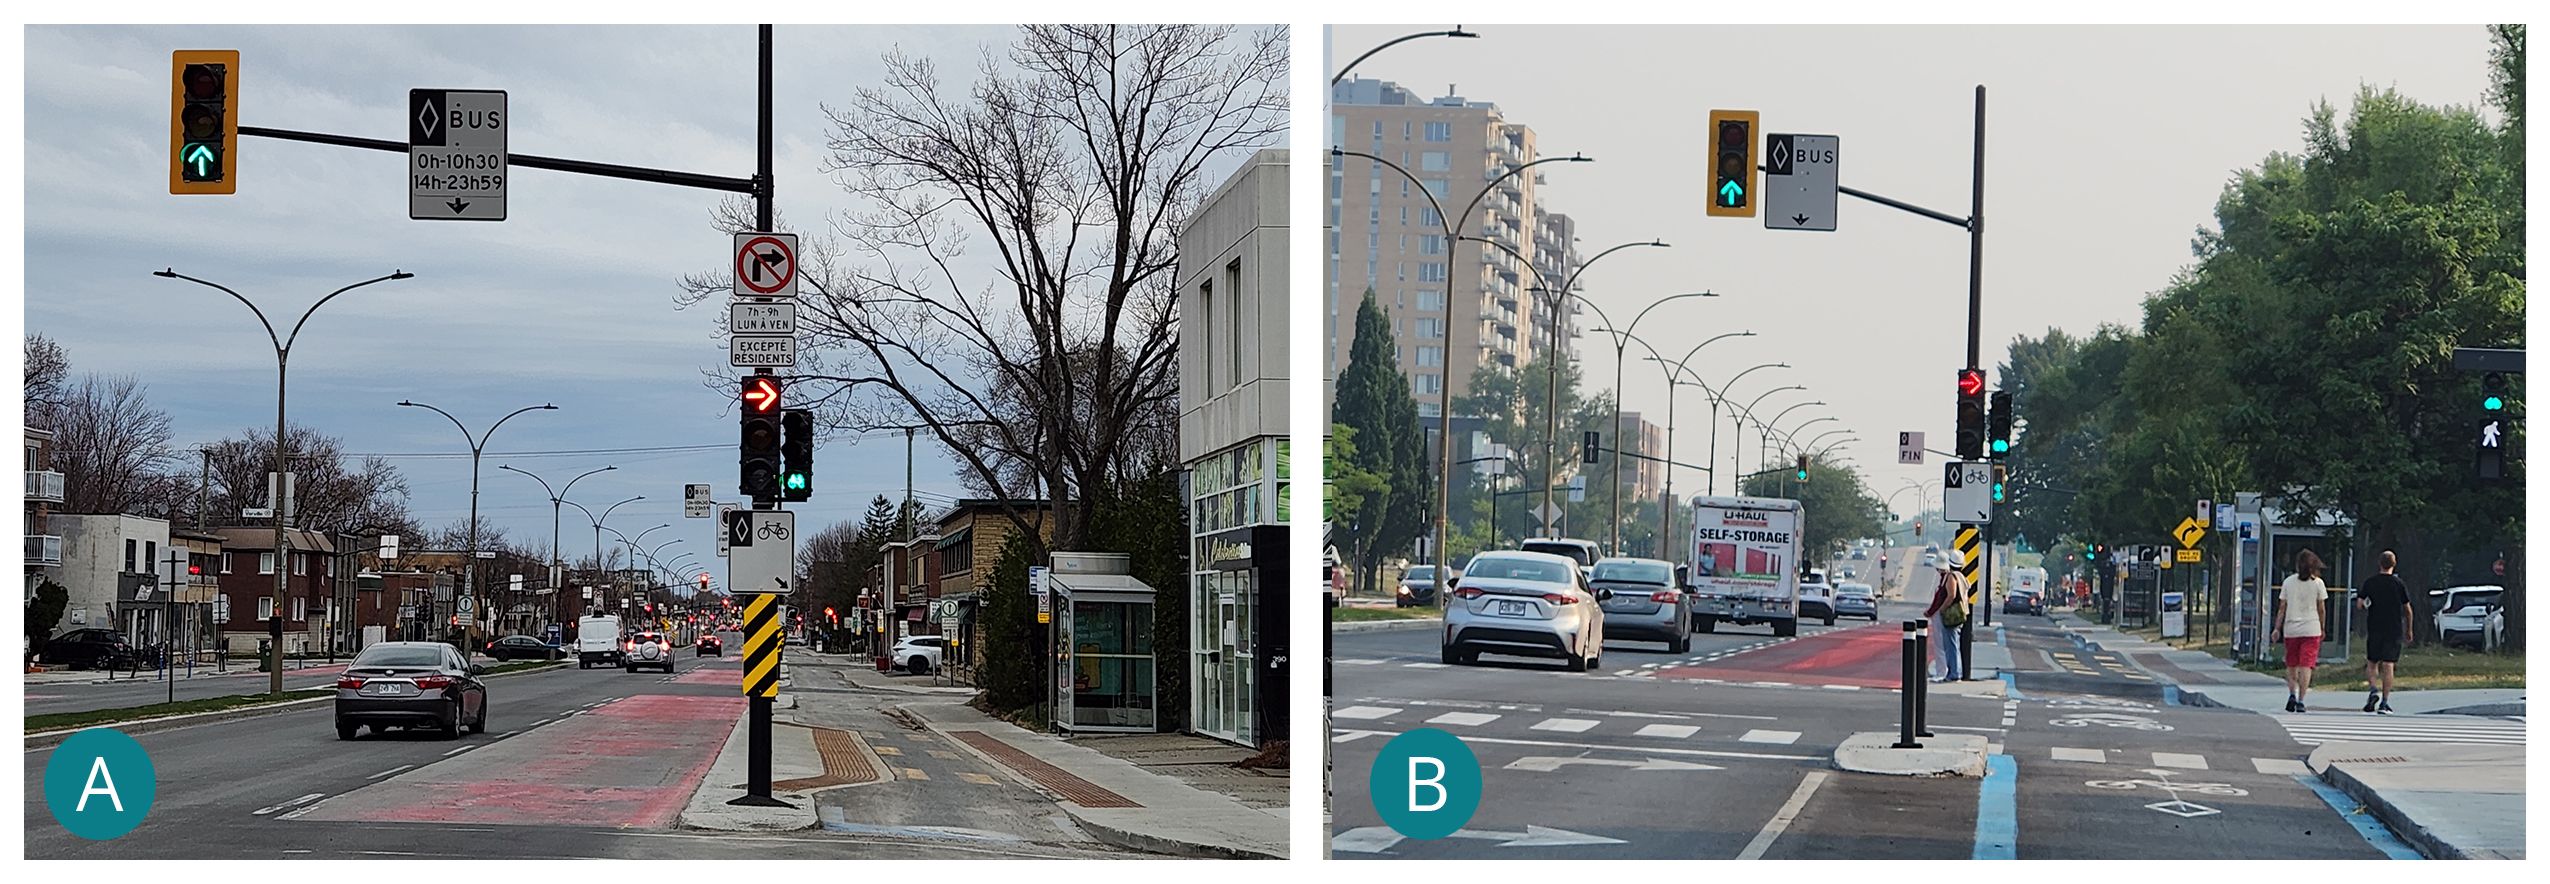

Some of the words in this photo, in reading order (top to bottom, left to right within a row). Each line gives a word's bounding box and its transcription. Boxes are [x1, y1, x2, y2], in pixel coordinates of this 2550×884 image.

[450, 110, 500, 129] BUS
[417, 153, 499, 169] 0h-10h30
[1796, 149, 1833, 164] BUS
[414, 174, 503, 190] 14h-23h59
[747, 307, 759, 317] 7h
[767, 307, 779, 317] 9h
[737, 320, 757, 330] LUN
[760, 317, 767, 329] À
[769, 320, 789, 330] VEN
[734, 351, 793, 364] RÉSIDENTS
[1902, 450, 1921, 461] FIN
[1699, 528, 1790, 544] SELF-STORAGE
[1272, 655, 1287, 663] 390
